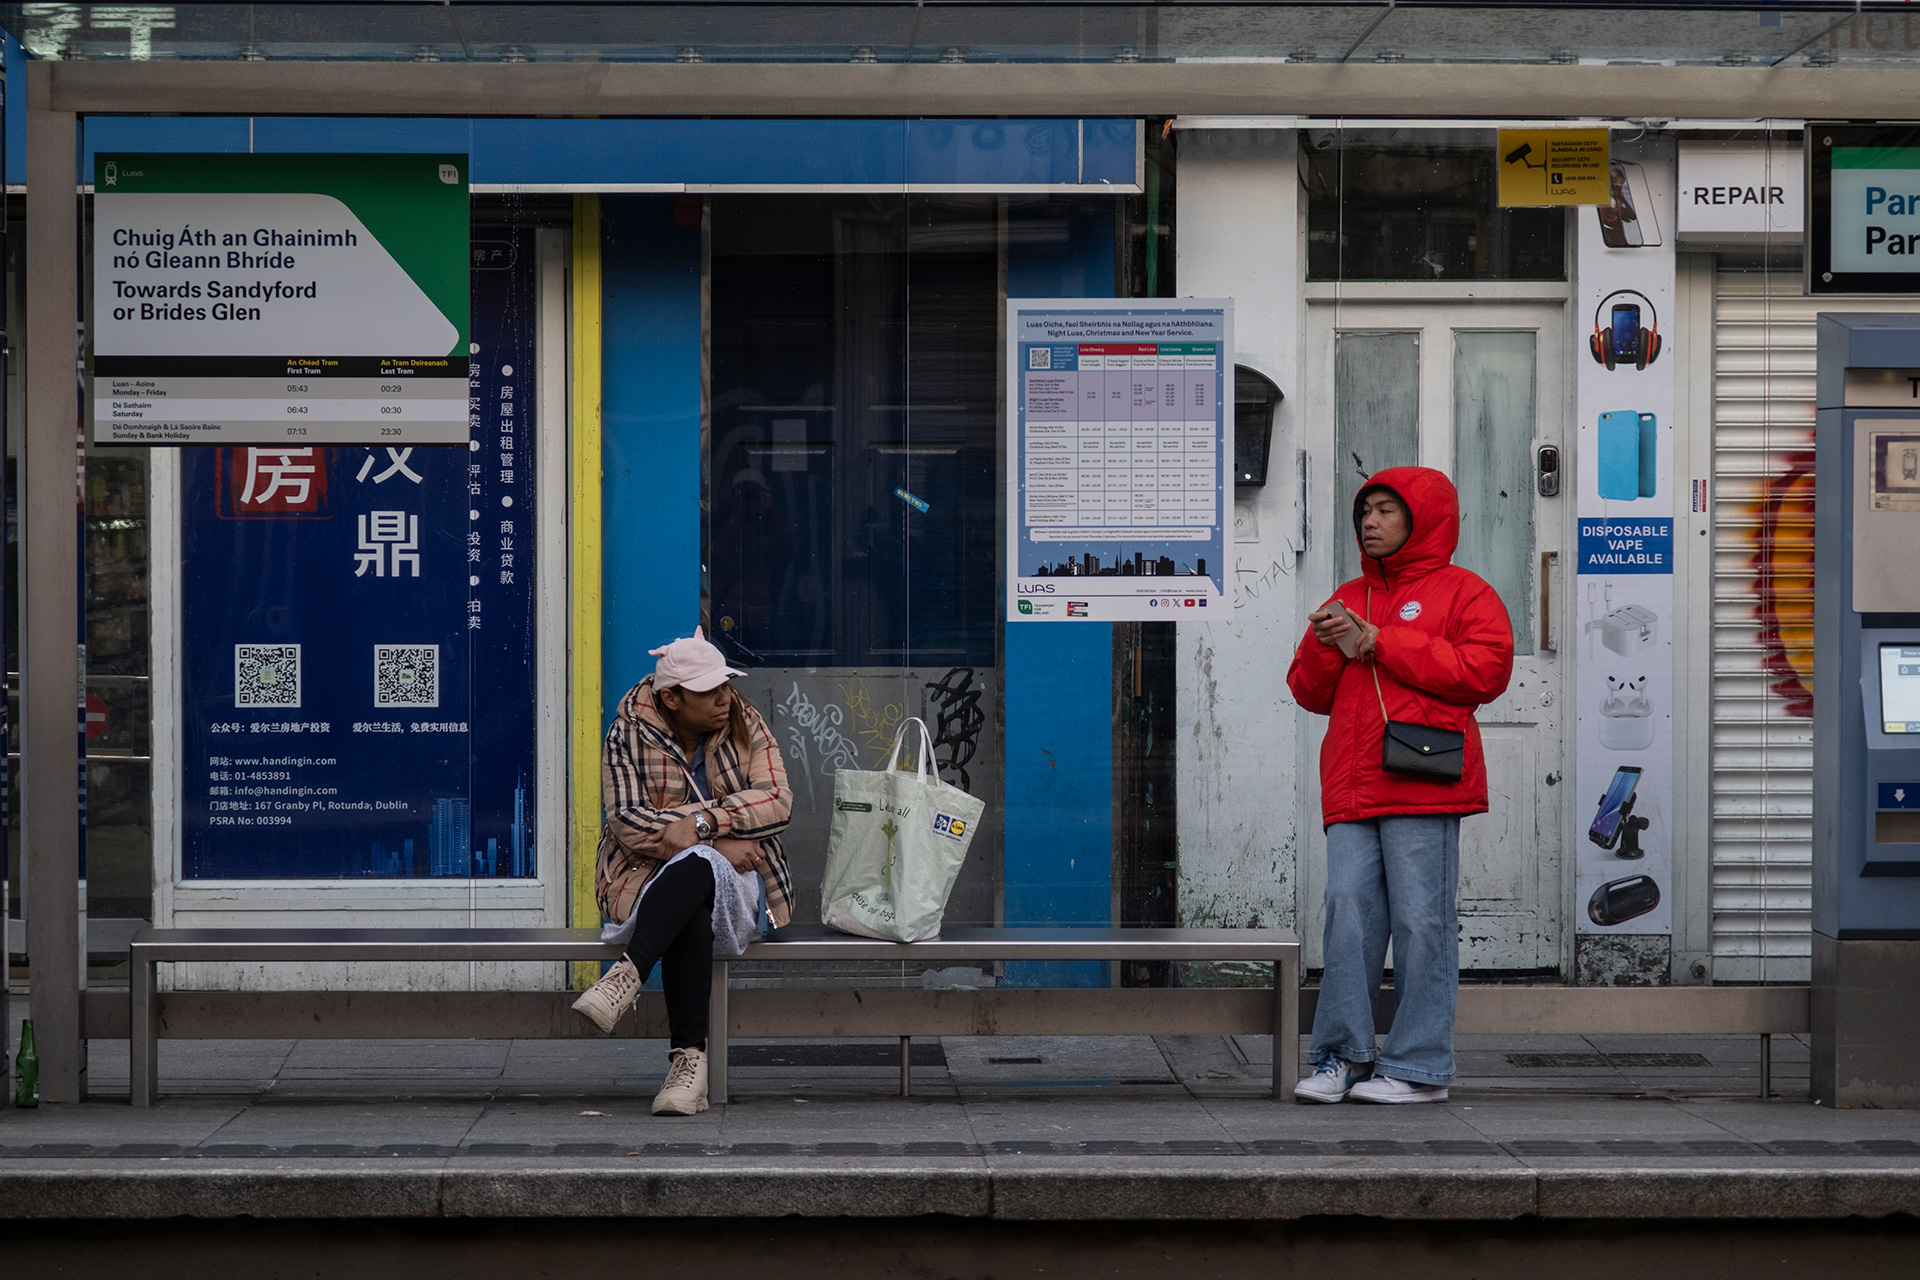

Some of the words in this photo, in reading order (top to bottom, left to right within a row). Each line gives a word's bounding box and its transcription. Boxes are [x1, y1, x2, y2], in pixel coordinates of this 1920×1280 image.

[1695, 187, 1784, 204] REPAIR
[1866, 187, 1920, 215] Par
[113, 229, 174, 250] Chuig
[178, 224, 215, 246] Áth
[223, 234, 246, 246] an
[254, 229, 356, 246] Ghainimh
[1866, 226, 1920, 254] Par
[114, 252, 140, 269] nó
[146, 252, 220, 269] Gleann
[228, 252, 295, 269] Bhríde
[113, 281, 201, 298] Towards
[207, 281, 316, 302] Sandyford
[114, 308, 136, 321] or
[141, 304, 206, 321] Brides
[212, 304, 261, 321] Glen
[1122, 321, 1144, 329] Nollag
[1047, 330, 1066, 338] Night
[499, 385, 514, 484] 房屋出租管理
[1583, 526, 1668, 536] DISPOSABLE
[1608, 540, 1643, 550] VAPE
[499, 520, 514, 584] 商业贷款
[1589, 554, 1662, 564] AVAILABLE
[1018, 583, 1055, 593] LUAS
[210, 757, 232, 766] 网站:
[235, 757, 336, 767] www.handingin.com
[210, 771, 232, 781] 电话:
[235, 772, 290, 780] 01-4853891
[210, 786, 232, 795] 邮箱:
[235, 786, 337, 797] info@handingin.com
[210, 801, 251, 810] 门店地址:
[255, 802, 271, 810] 167
[275, 801, 310, 811] Granby
[313, 801, 325, 811] Pl,
[329, 801, 372, 810] Rotunda,
[376, 801, 408, 809] Dublin
[210, 817, 235, 825] PSRA
[238, 817, 254, 825] No:
[257, 816, 291, 824] 003994
[852, 891, 868, 910] euse
